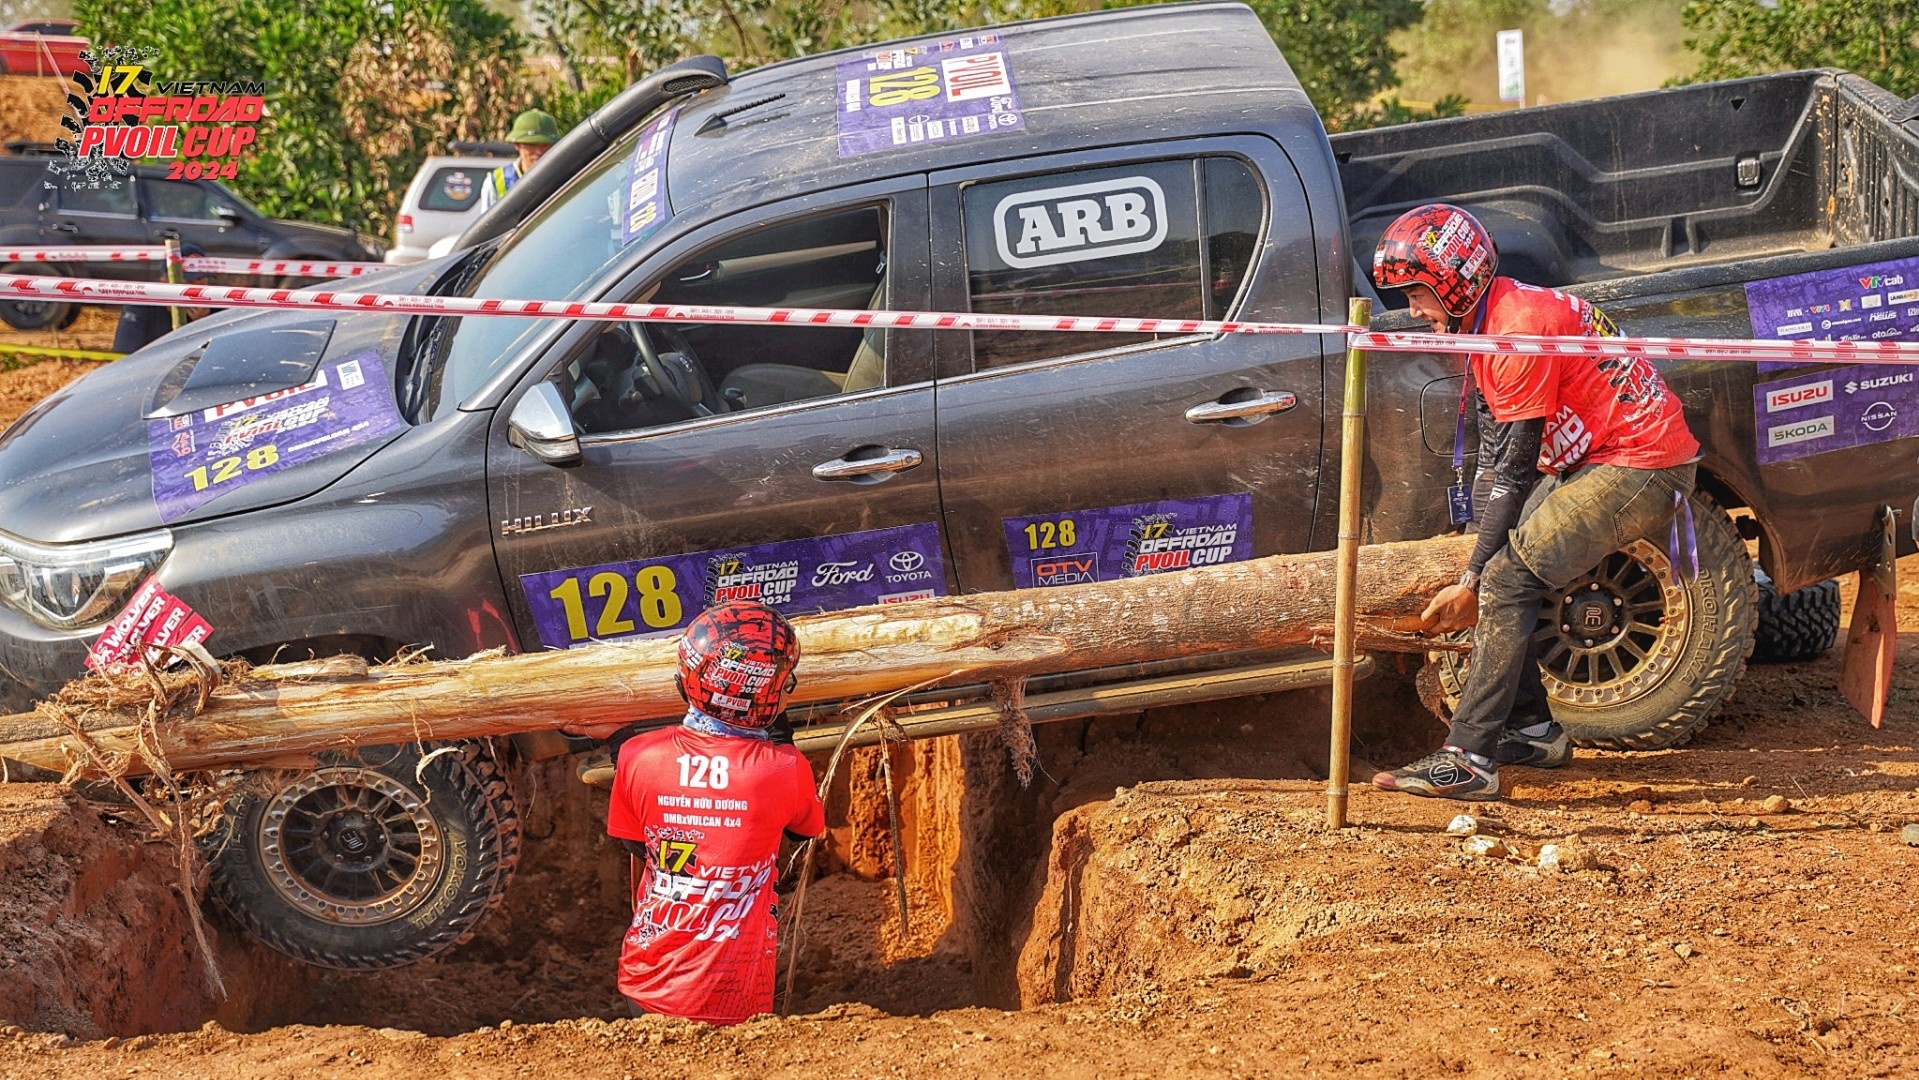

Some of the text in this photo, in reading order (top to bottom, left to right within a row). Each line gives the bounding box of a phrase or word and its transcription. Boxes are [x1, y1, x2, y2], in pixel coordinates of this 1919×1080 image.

[868, 66, 941, 107] 128
[947, 54, 1004, 97] PVOIL
[1016, 192, 1151, 254] ARB
[1438, 219, 1472, 265] PVOIL CUP
[1468, 245, 1485, 266] PVOIL
[1772, 373, 1914, 407] ISUZU SUZUKI
[1861, 411, 1898, 422] NISSAN
[184, 444, 280, 492] 128
[501, 506, 593, 536] HILUX
[1143, 523, 1237, 540] 17 VIETNAM
[1024, 519, 1077, 551] 128
[1138, 530, 1237, 555] OFFROAD
[720, 560, 799, 575] 17 VIETNAM
[1036, 557, 1093, 578] OTV
[1134, 545, 1233, 572] PVOIL CUP
[717, 566, 799, 588] OFFROAD
[812, 560, 874, 587] Ford
[886, 570, 932, 583] TOYOTA
[1037, 570, 1096, 587] MEDIA
[550, 565, 684, 641] 128
[715, 579, 797, 603] PVOIL CUP
[758, 594, 791, 606] 2024
[104, 583, 157, 648] WOLVER
[720, 657, 776, 677] OFFROAD
[725, 648, 778, 669] 17 VIETNAM
[713, 667, 771, 687] PVOIL CUP
[725, 696, 748, 708] PVOIL
[740, 686, 763, 694] 2024
[676, 753, 729, 790] 128
[663, 812, 742, 828] DMBxVULCAN 4x4
[659, 840, 697, 873] 17
